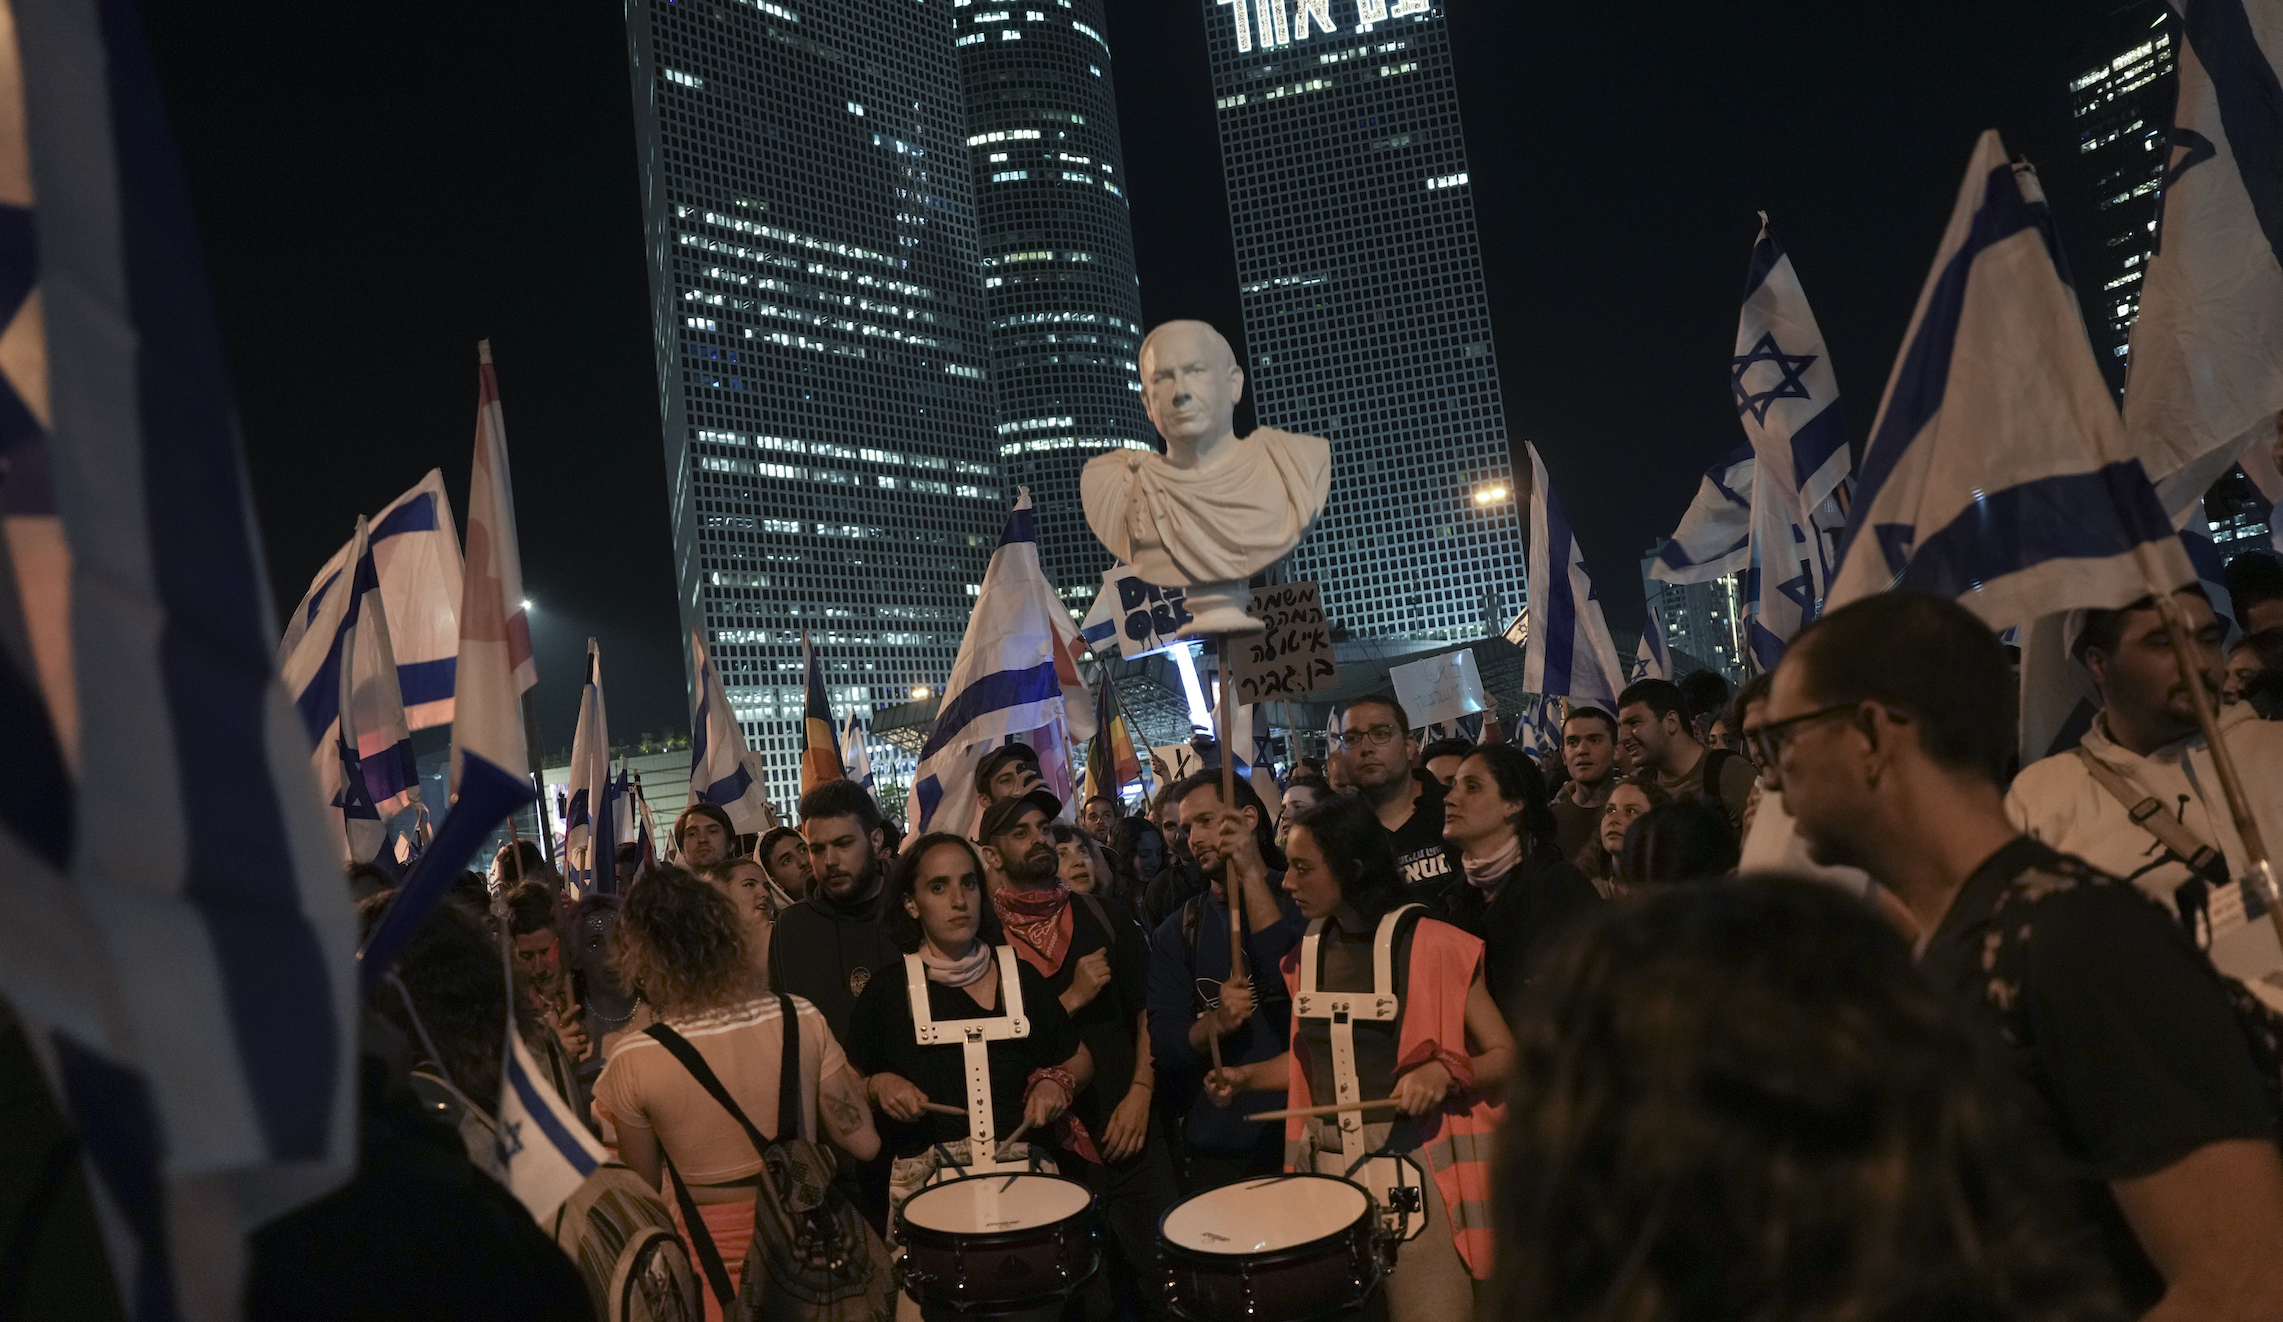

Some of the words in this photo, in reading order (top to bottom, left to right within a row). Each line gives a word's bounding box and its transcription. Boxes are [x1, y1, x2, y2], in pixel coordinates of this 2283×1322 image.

[1247, 588, 1314, 612] משמר
[1125, 604, 1193, 642] OBE
[1262, 607, 1323, 630] המהפ
[1399, 853, 1452, 884] אמנ
